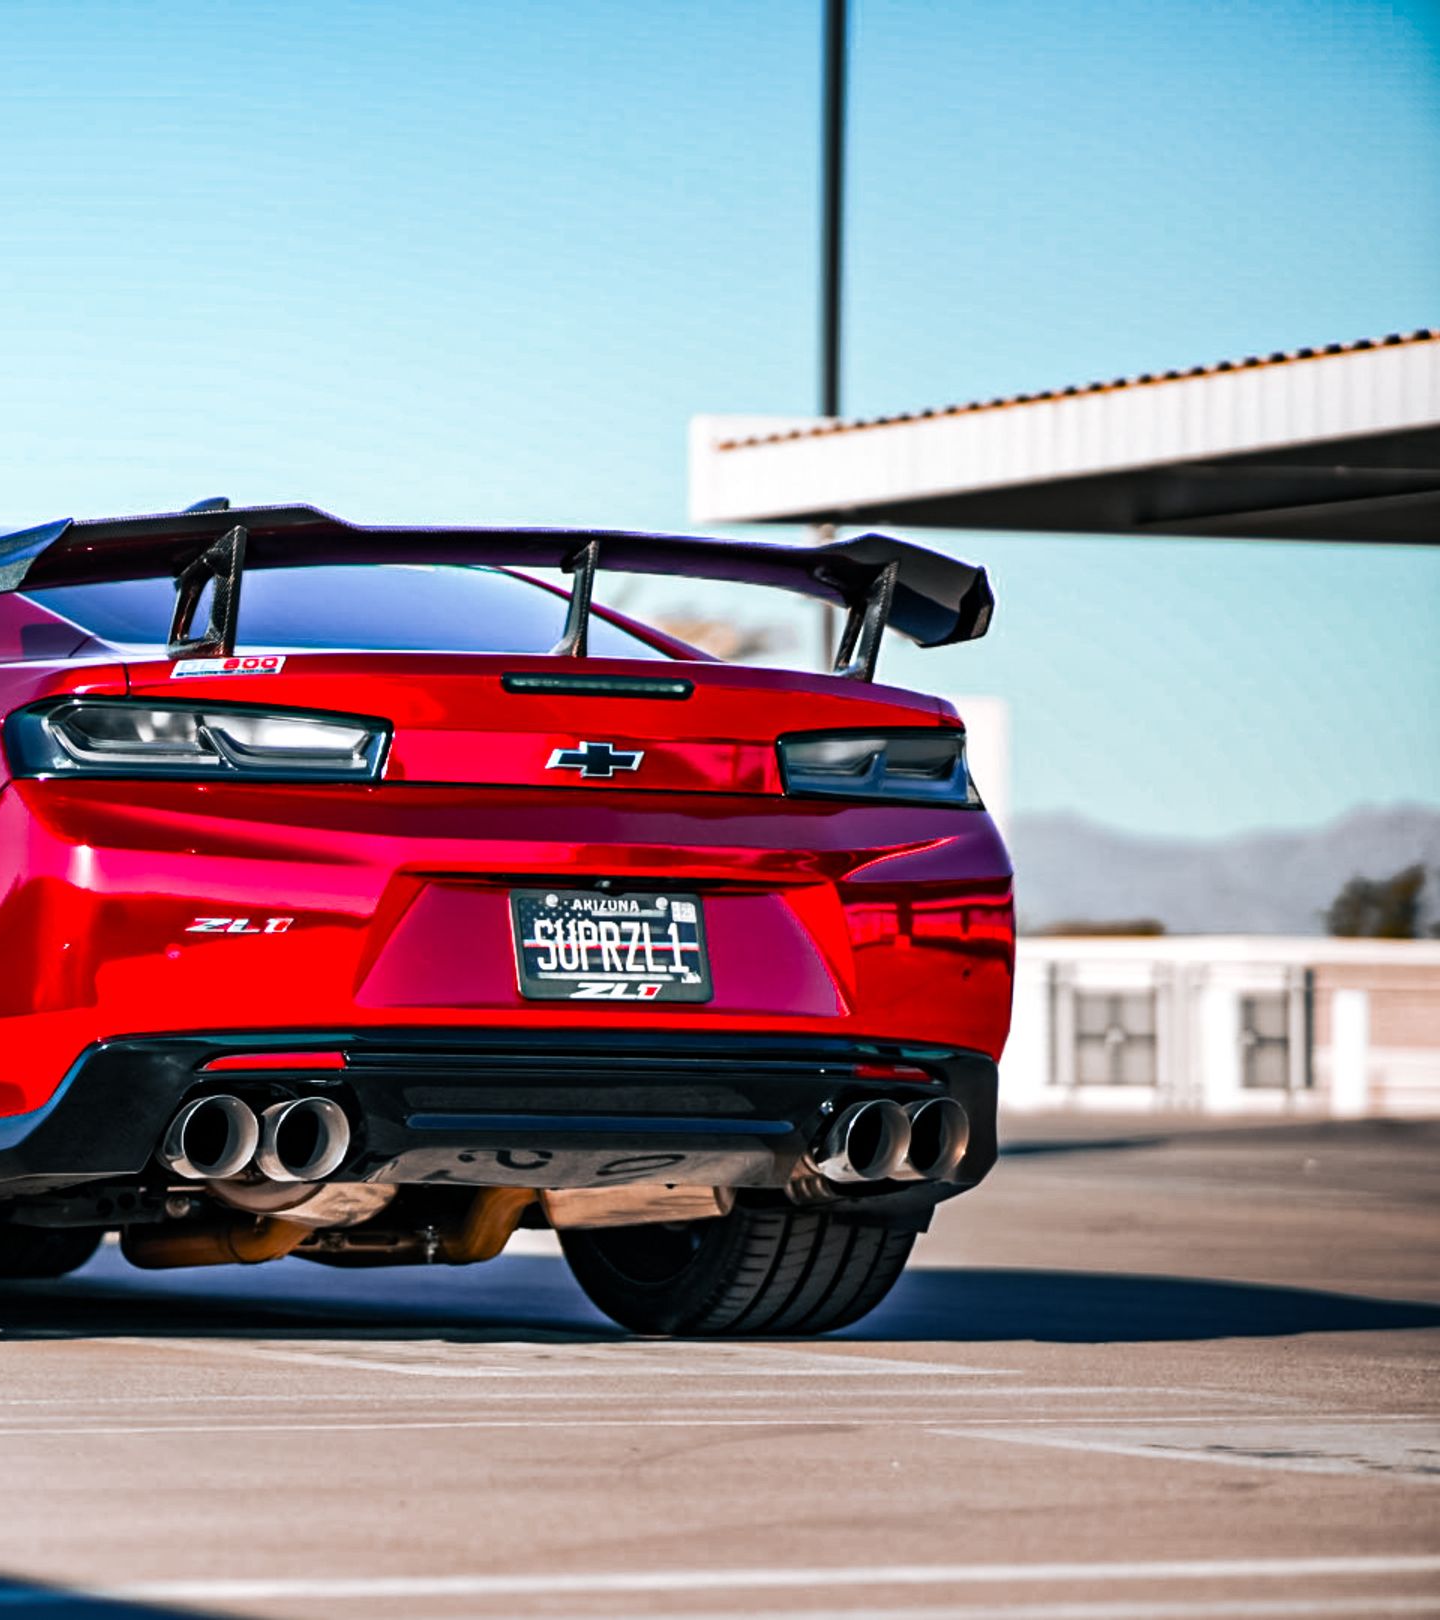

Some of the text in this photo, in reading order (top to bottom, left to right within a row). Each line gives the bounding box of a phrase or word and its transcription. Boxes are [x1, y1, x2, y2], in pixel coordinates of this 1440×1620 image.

[572, 899, 640, 912] ARIZONA
[185, 917, 294, 933] ZL1
[534, 918, 690, 973] SUPRZL1
[569, 982, 662, 1000] ZL1
